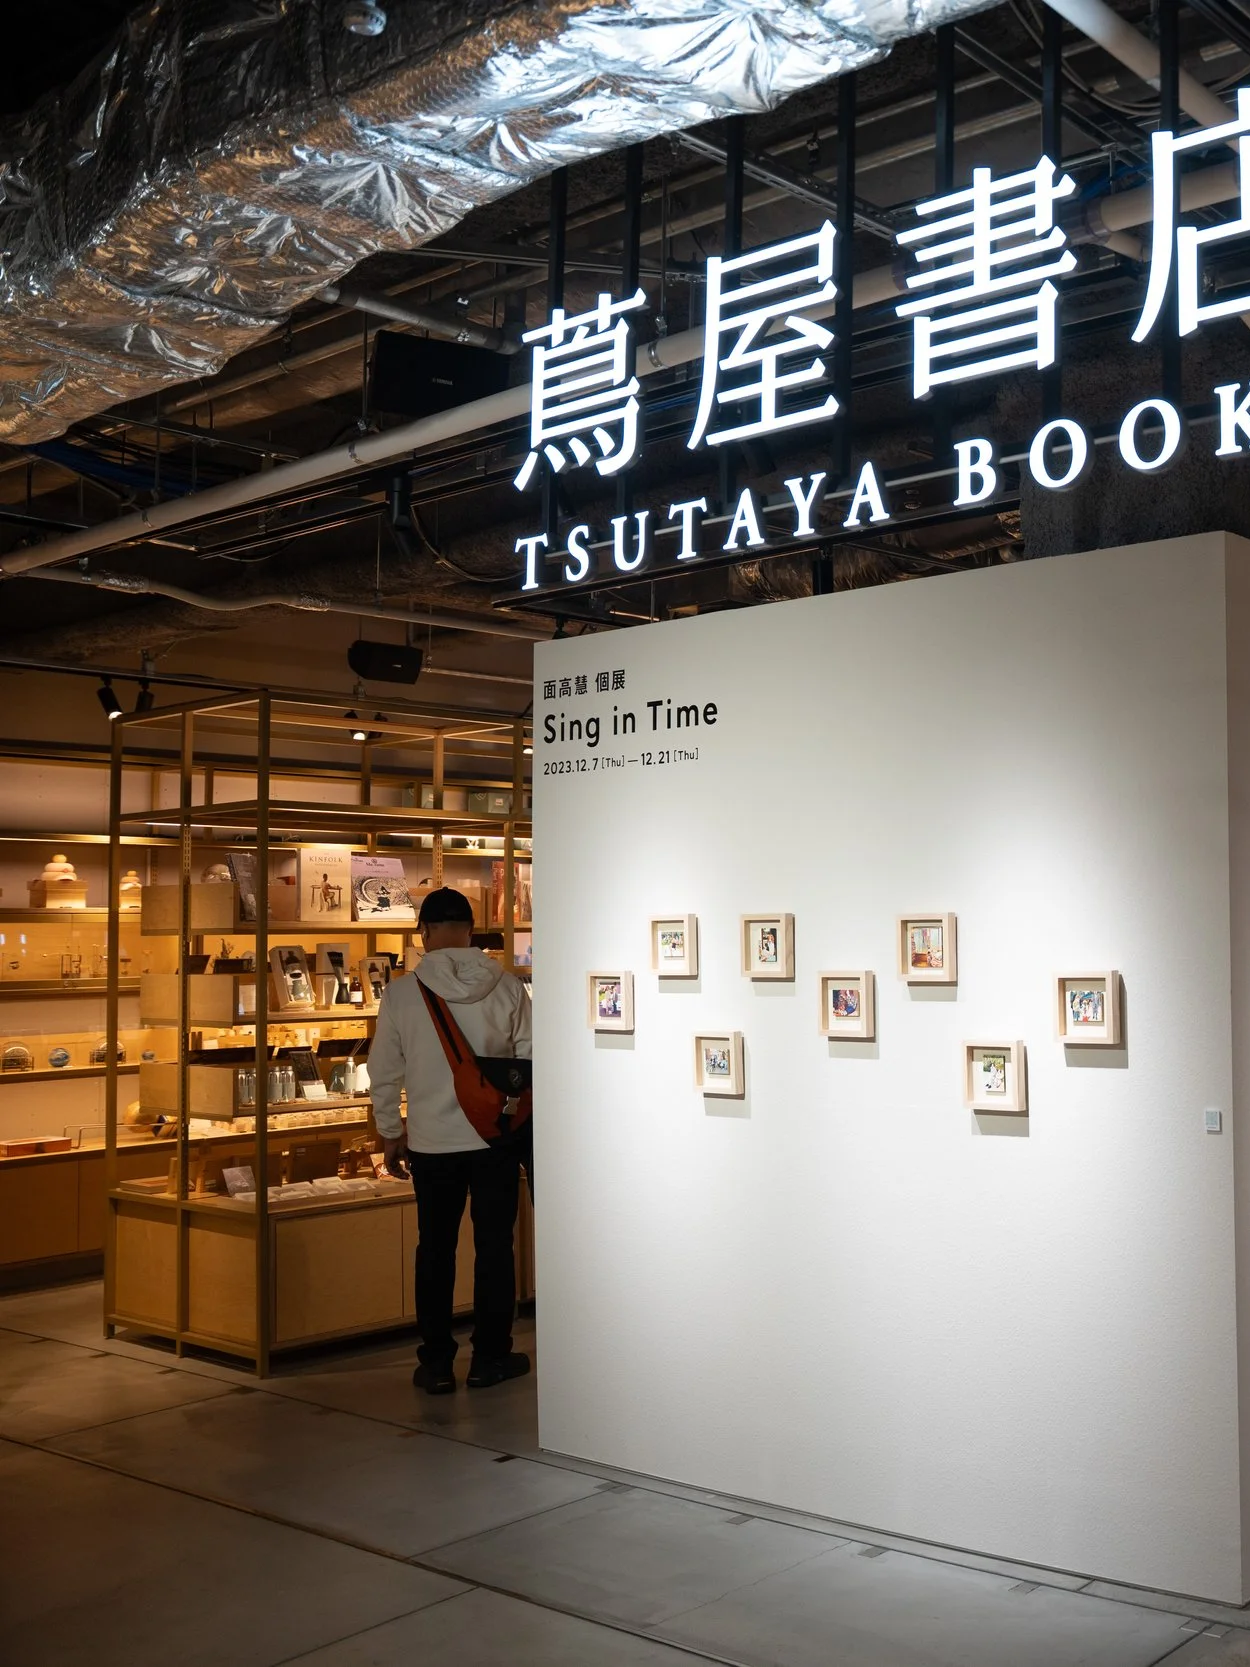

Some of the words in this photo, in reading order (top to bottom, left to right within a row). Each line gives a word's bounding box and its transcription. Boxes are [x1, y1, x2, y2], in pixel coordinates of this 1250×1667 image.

[515, 461, 890, 590] TSUTAYA
[543, 675, 588, 701] 面高慧
[595, 669, 626, 694] 個展
[543, 713, 601, 748] Sing
[613, 706, 636, 736] in
[646, 699, 718, 731] Time
